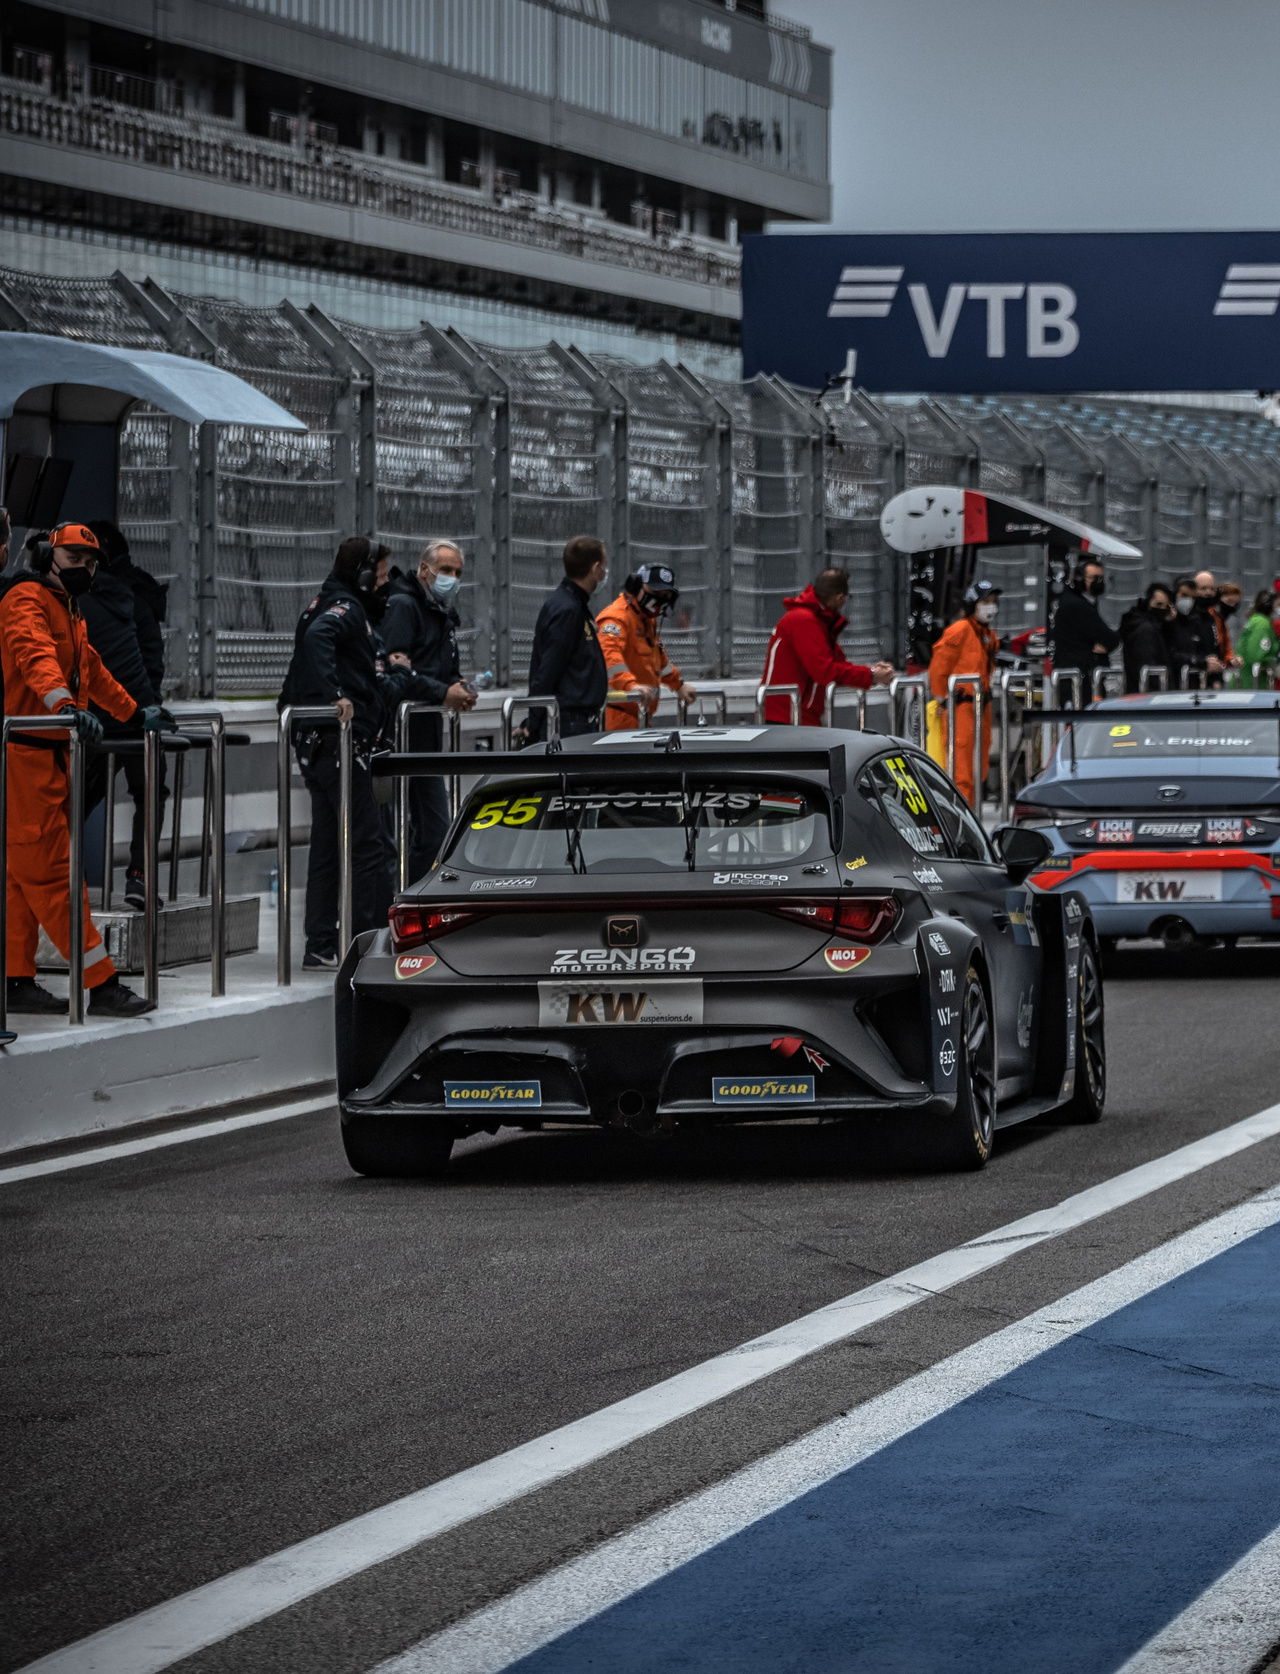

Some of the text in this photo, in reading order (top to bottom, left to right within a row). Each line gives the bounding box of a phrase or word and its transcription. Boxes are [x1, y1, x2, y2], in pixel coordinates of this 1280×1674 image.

[909, 284, 1079, 358] VTB
[1109, 725, 1131, 737] 8
[1167, 737, 1252, 747] Engstler
[885, 757, 928, 815] 55
[470, 796, 542, 830] 55
[1099, 819, 1133, 832] LIQUI
[1207, 819, 1242, 831] LIQUI
[1098, 832, 1133, 842] MOLY
[1206, 832, 1242, 841] MOLY
[1134, 881, 1186, 901] KW
[831, 950, 857, 960] MOL
[400, 957, 424, 968] MOL
[550, 962, 693, 973] MOTORSPORT
[566, 992, 693, 1024] KW suspensions.de
[451, 1085, 534, 1102] GOODYEAR
[719, 1080, 808, 1098] GOODYEAR
